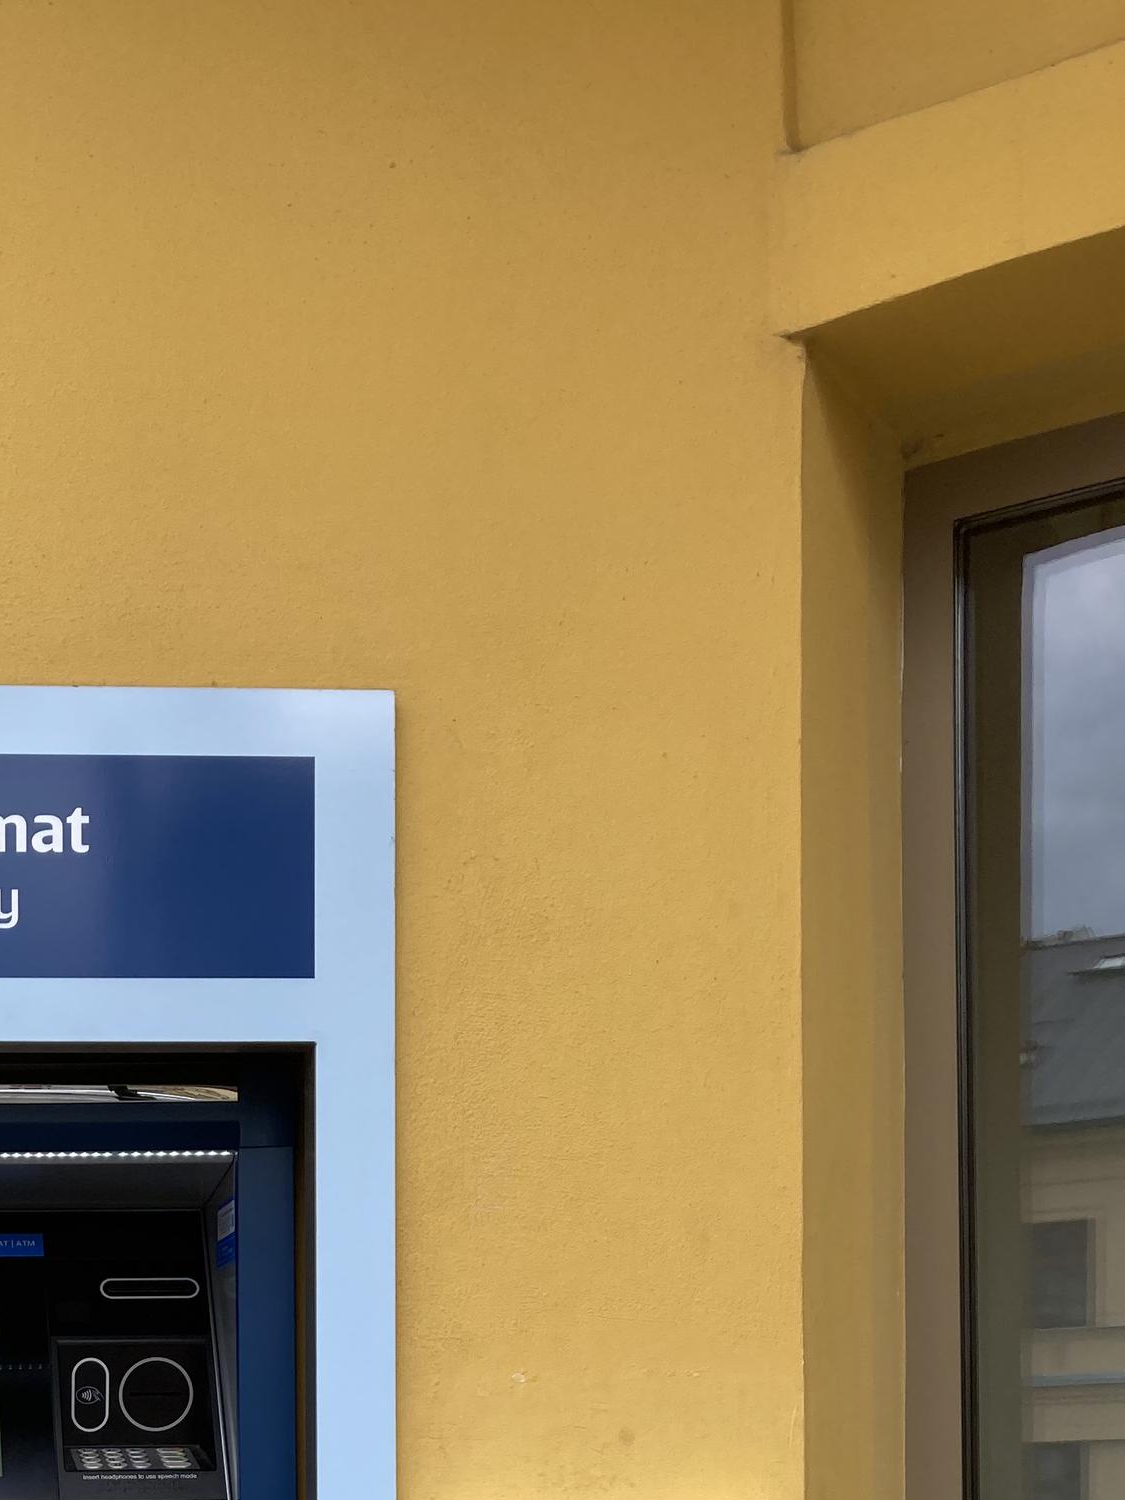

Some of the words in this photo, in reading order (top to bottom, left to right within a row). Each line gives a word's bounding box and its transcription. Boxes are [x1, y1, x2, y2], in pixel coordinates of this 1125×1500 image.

[15, 1239, 36, 1248] ATM
[100, 1473, 137, 1481] headphones
[180, 1472, 198, 1480] mode
